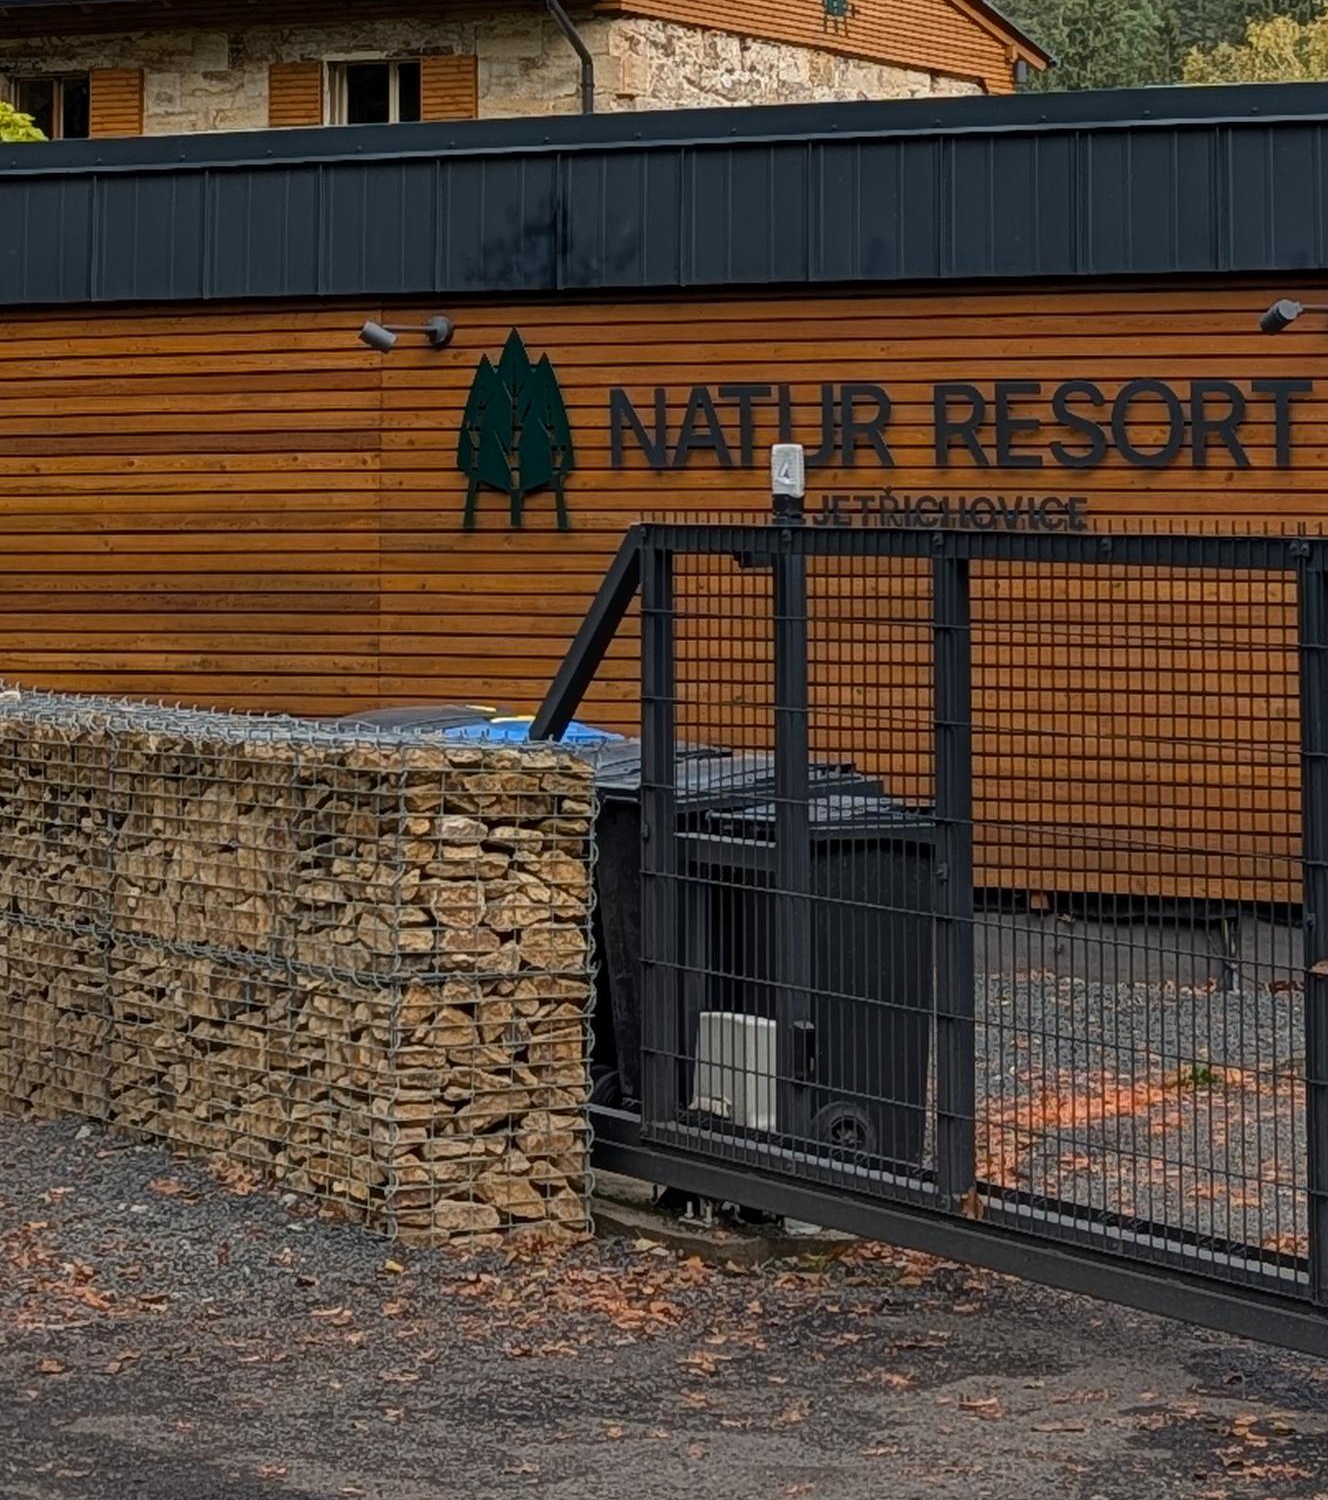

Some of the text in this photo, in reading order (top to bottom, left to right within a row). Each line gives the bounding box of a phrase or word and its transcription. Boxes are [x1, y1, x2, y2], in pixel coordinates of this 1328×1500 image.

[609, 378, 1314, 469] NATUR RESORT
[812, 486, 1088, 531] JETŘICHOVICE
